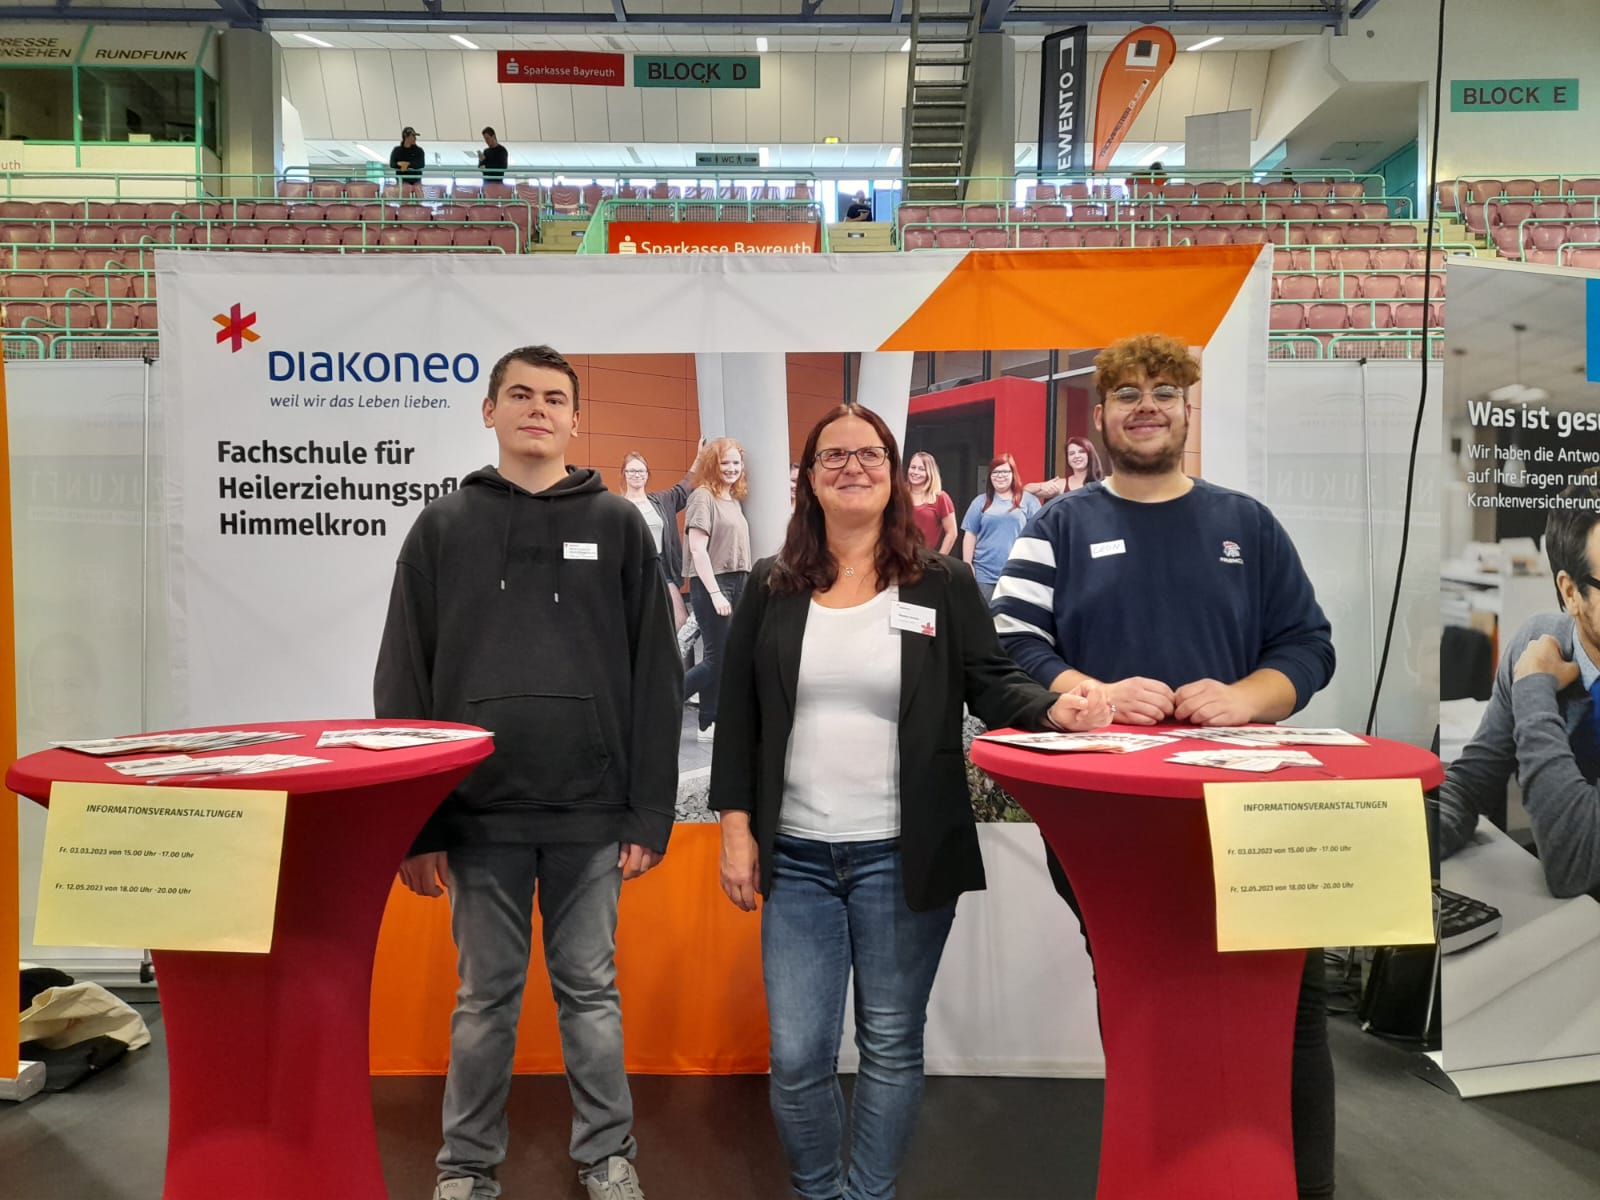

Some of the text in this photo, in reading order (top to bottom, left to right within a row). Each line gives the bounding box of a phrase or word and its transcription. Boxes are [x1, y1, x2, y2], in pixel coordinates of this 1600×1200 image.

[0, 37, 59, 47] RESSE
[95, 49, 188, 60] RUNDFUNK
[523, 65, 615, 79] Sparkasse Bayreuth
[647, 62, 747, 81] BLOCK D
[1463, 86, 1567, 105] BLOCK E
[1057, 72, 1075, 176] EWENTO
[270, 394, 451, 409] weil wir das Leben lieben.
[1467, 400, 1600, 438] Was ist ges
[218, 440, 415, 465] Fachschule für
[1467, 444, 1600, 463] Wir haben die Antwo
[1467, 468, 1598, 489] auf Ihre Fragen rund
[220, 510, 386, 536] Himmelkron
[86, 804, 243, 819] INFORMATIONSVERANSTALTUNGEN
[1243, 801, 1388, 812] INFORMATIONSVERANSTALTUNGEN
[70, 847, 107, 855] 03.03.2023
[66, 883, 103, 891] 12.05.2023
[120, 885, 138, 893] 18.00
[178, 887, 191, 895] Uhr
